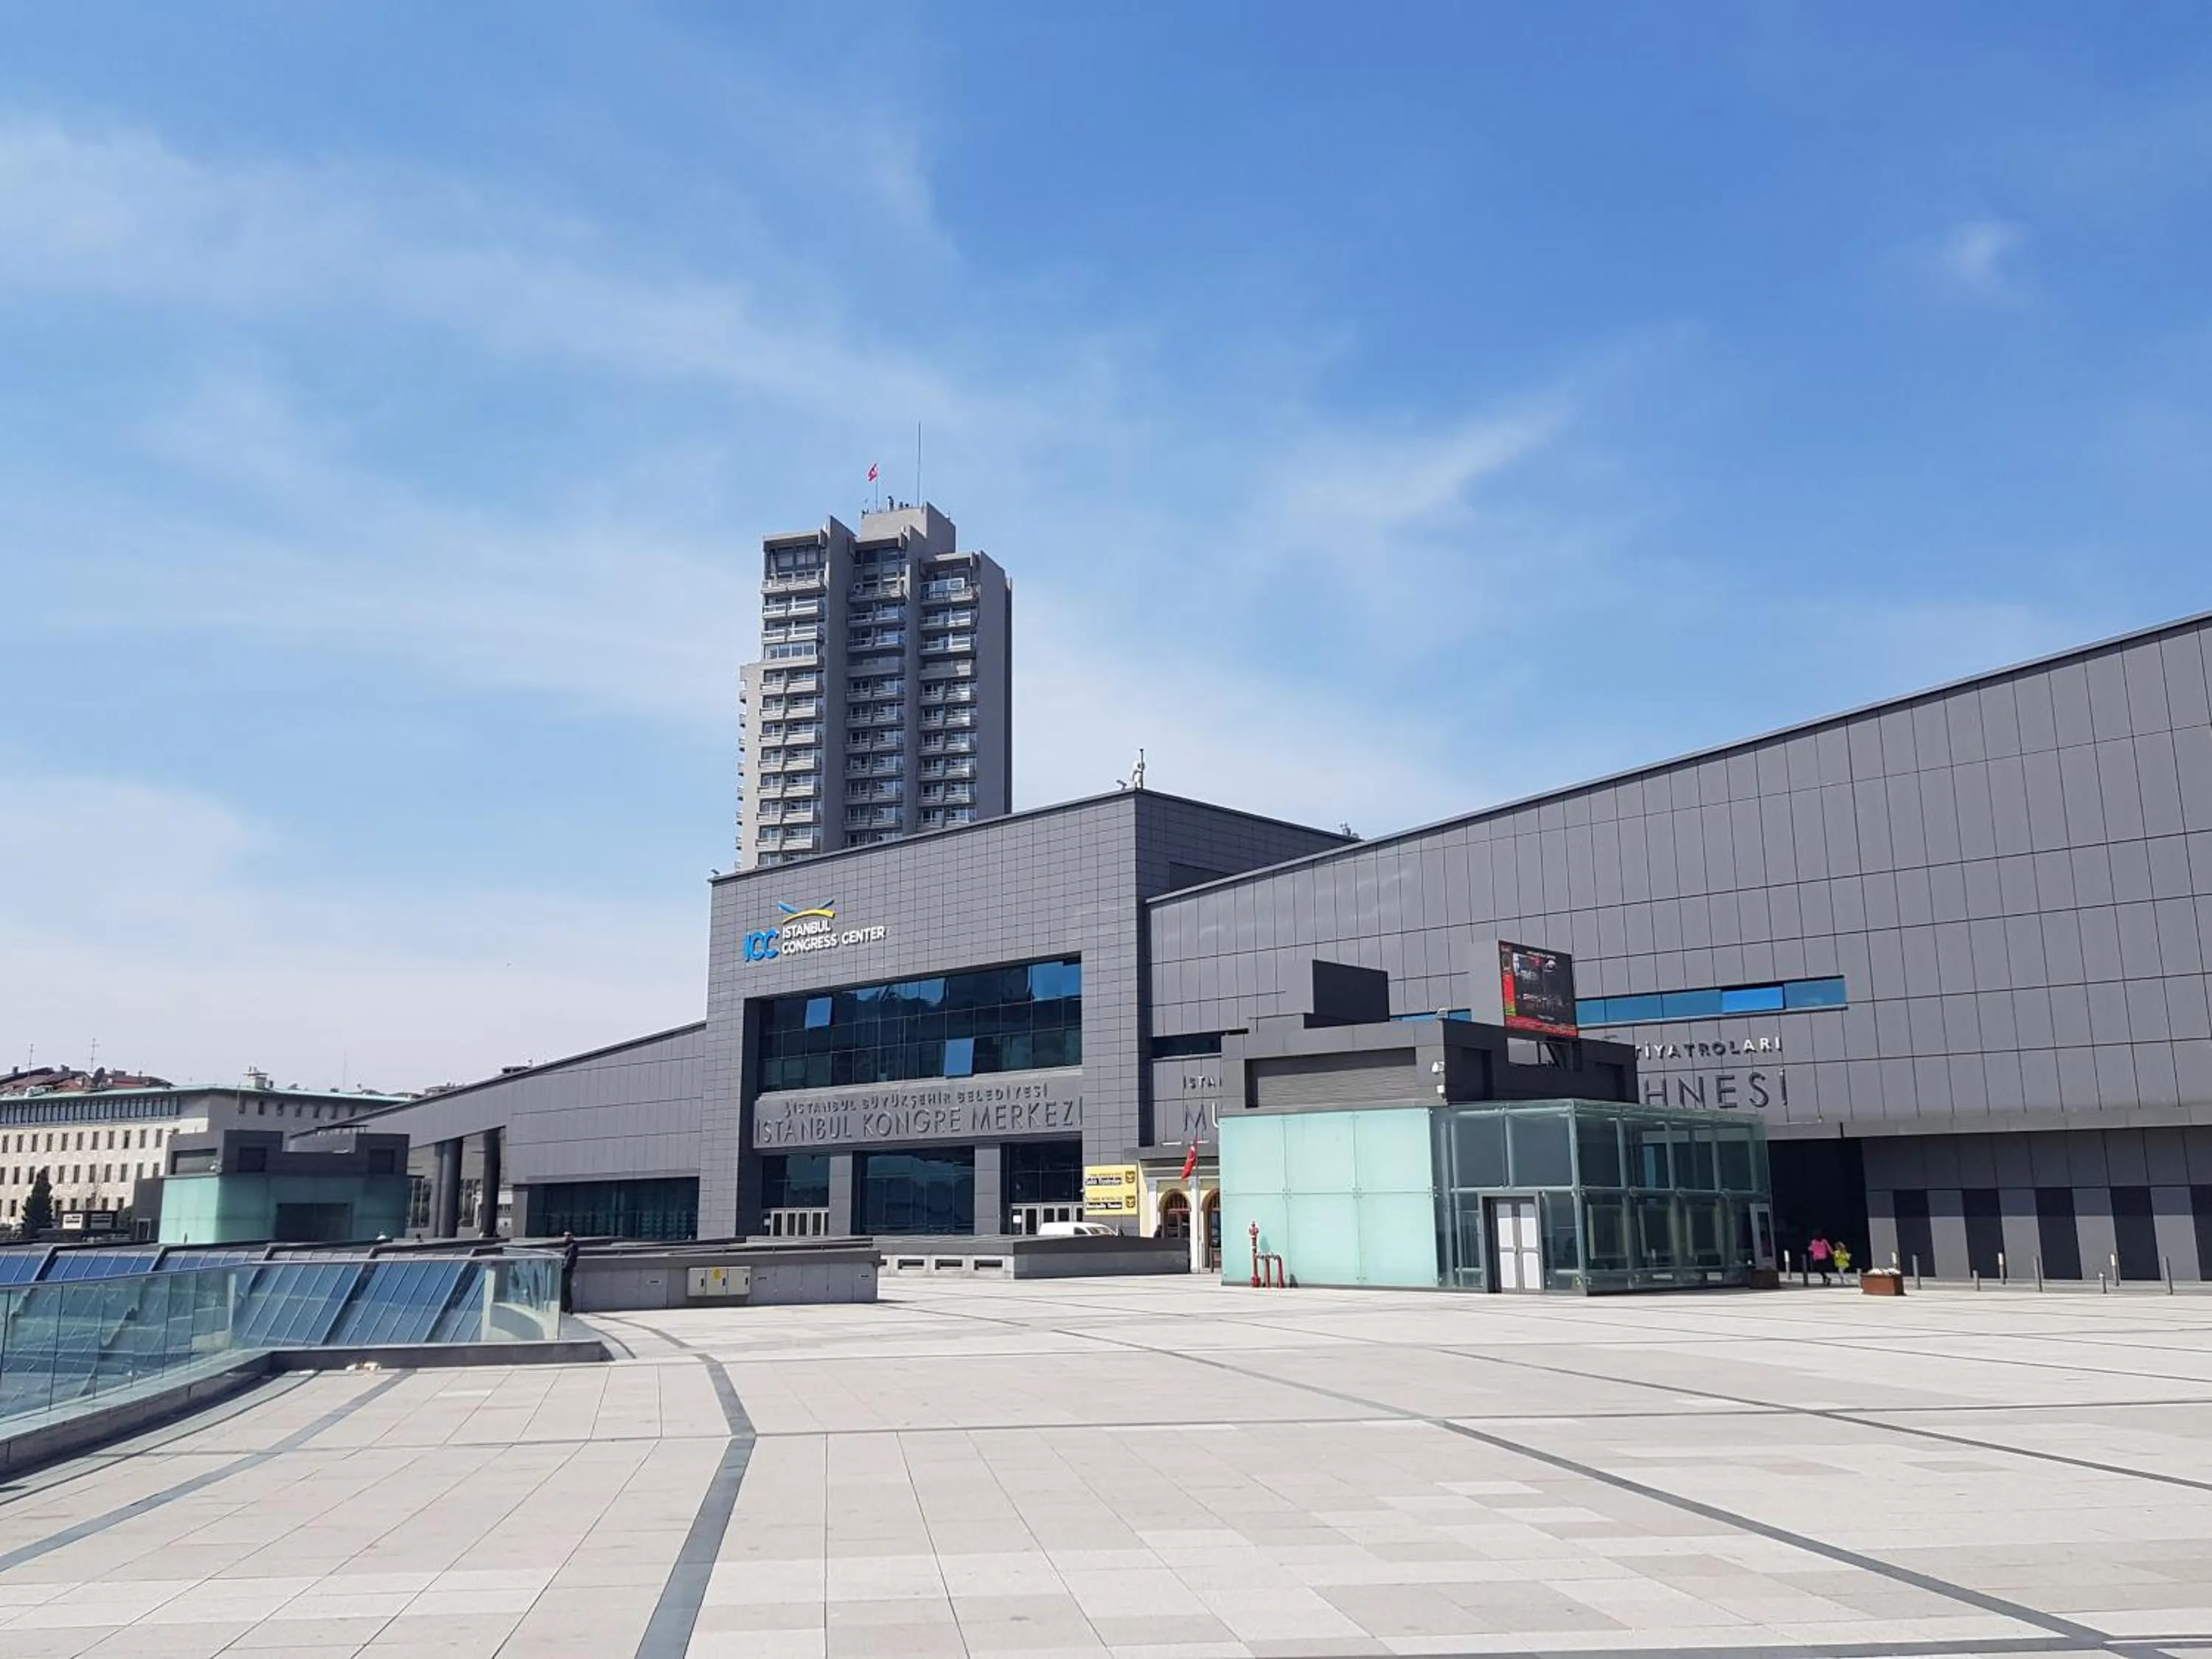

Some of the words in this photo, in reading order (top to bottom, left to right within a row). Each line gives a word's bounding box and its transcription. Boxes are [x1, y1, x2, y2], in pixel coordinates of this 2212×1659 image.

[782, 933, 838, 955] CONGRESS
[841, 925, 887, 945] CENTER
[1644, 1068, 1788, 1109] HNESİ
[863, 1106, 961, 1138] KONGRE
